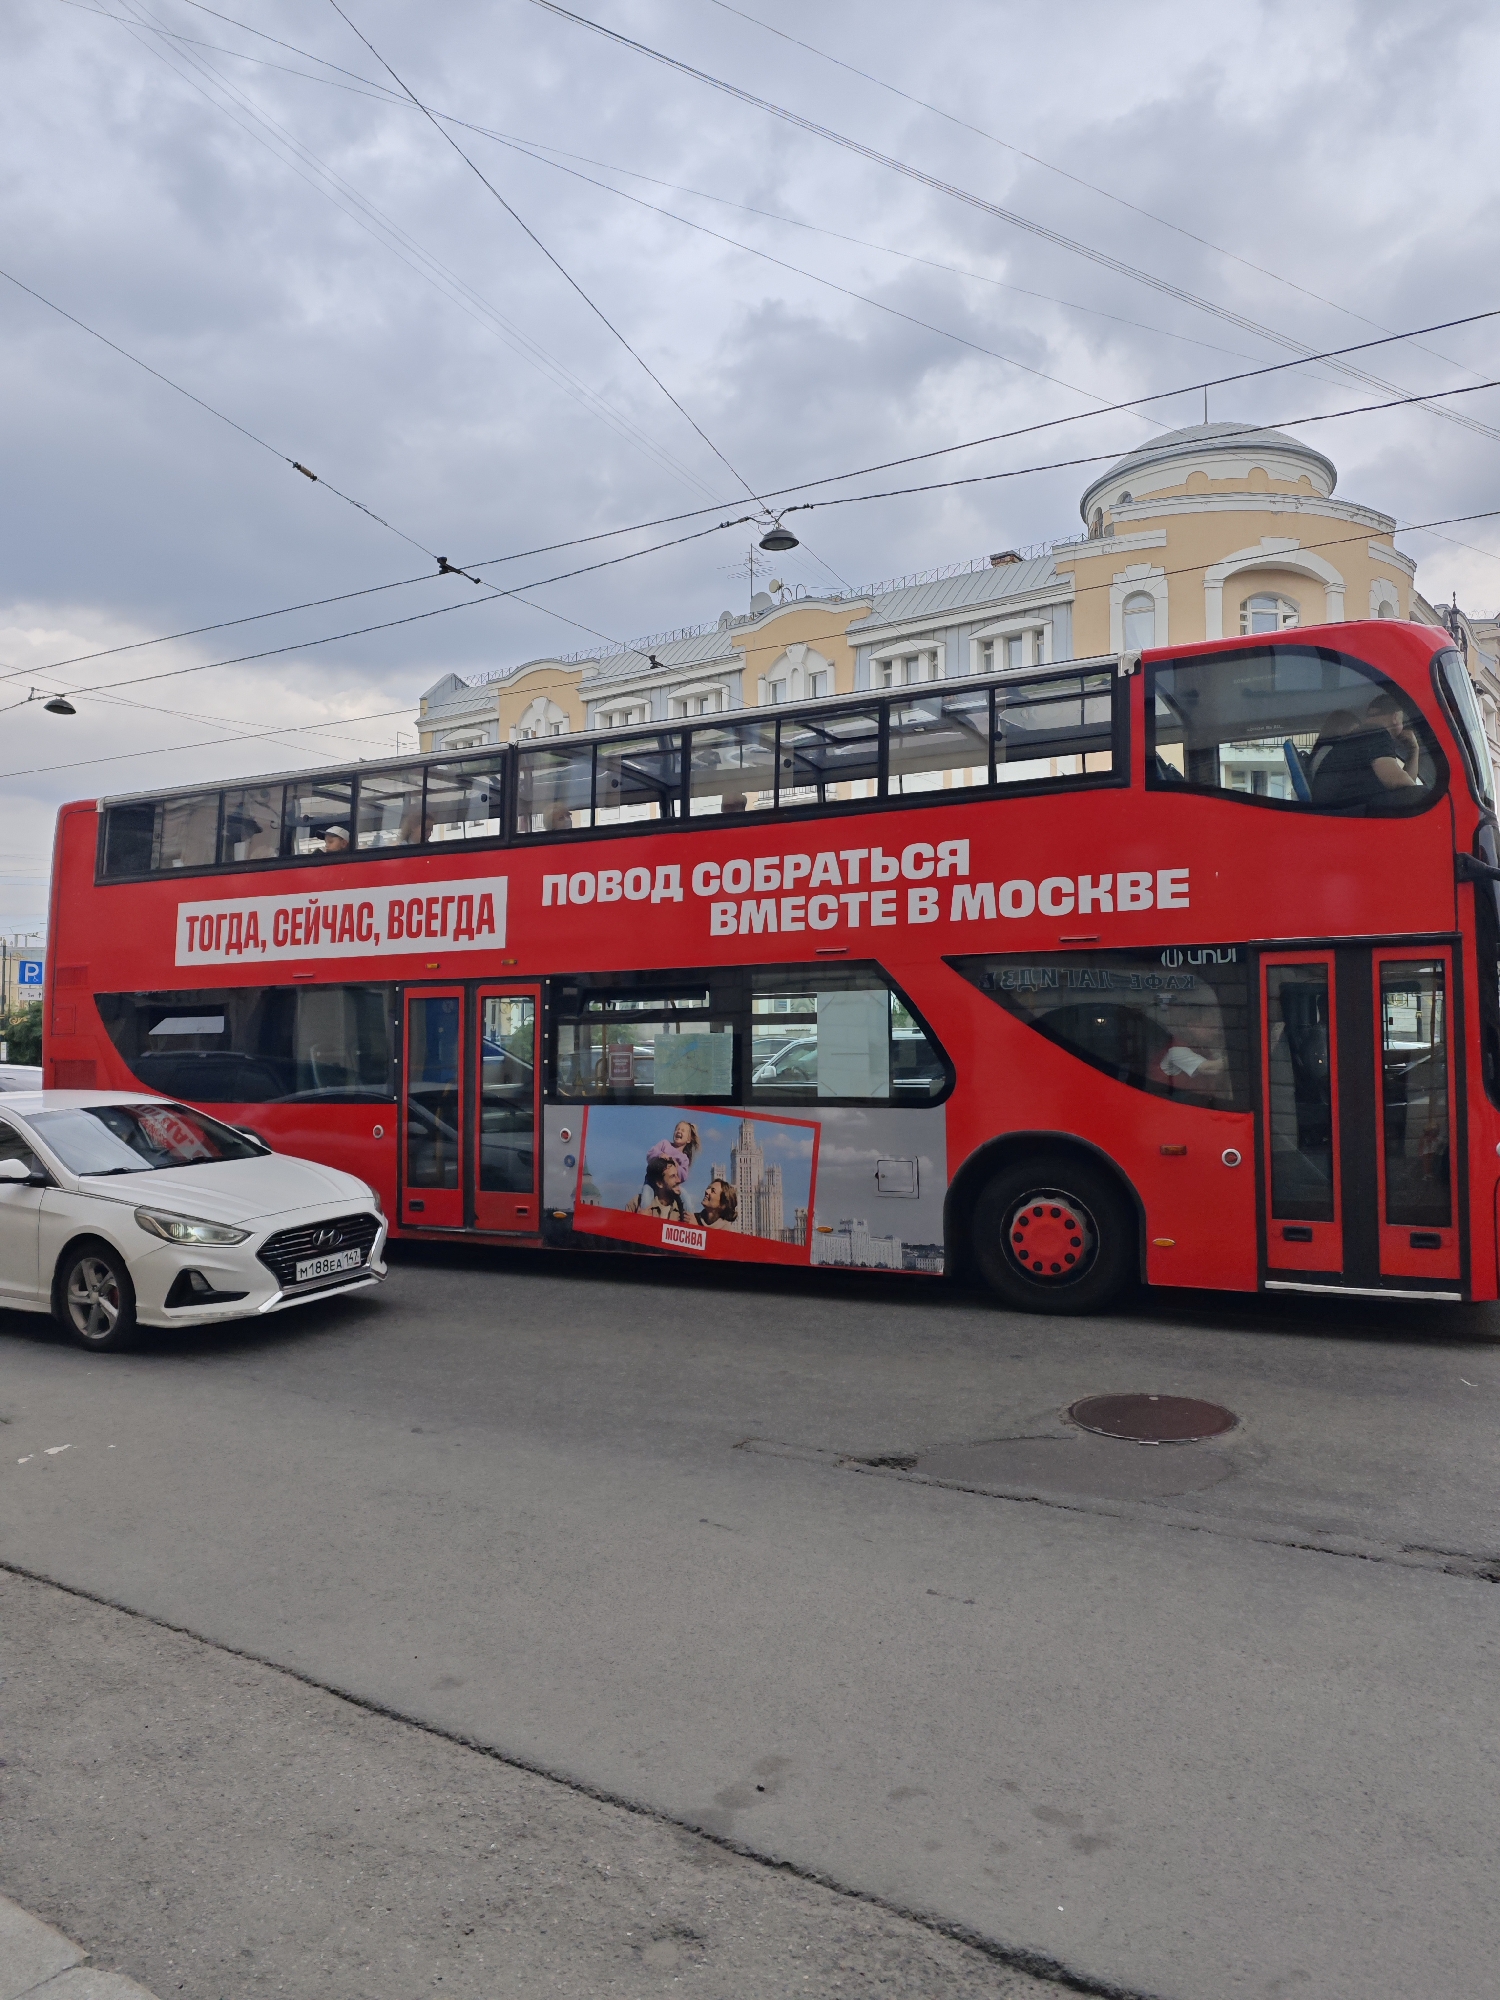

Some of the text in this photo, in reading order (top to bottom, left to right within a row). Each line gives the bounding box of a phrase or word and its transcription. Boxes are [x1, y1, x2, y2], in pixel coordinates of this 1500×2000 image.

[542, 839, 970, 907] ПОВОД СОБРАТЬСЯ
[710, 868, 1190, 936] ВМЕСТЕ В МОСКВЕ
[185, 892, 496, 956] ТОГДА, СЕЙЧАС, ВСЕГДА
[24, 963, 39, 983] P
[665, 1227, 703, 1247] МОСКВА
